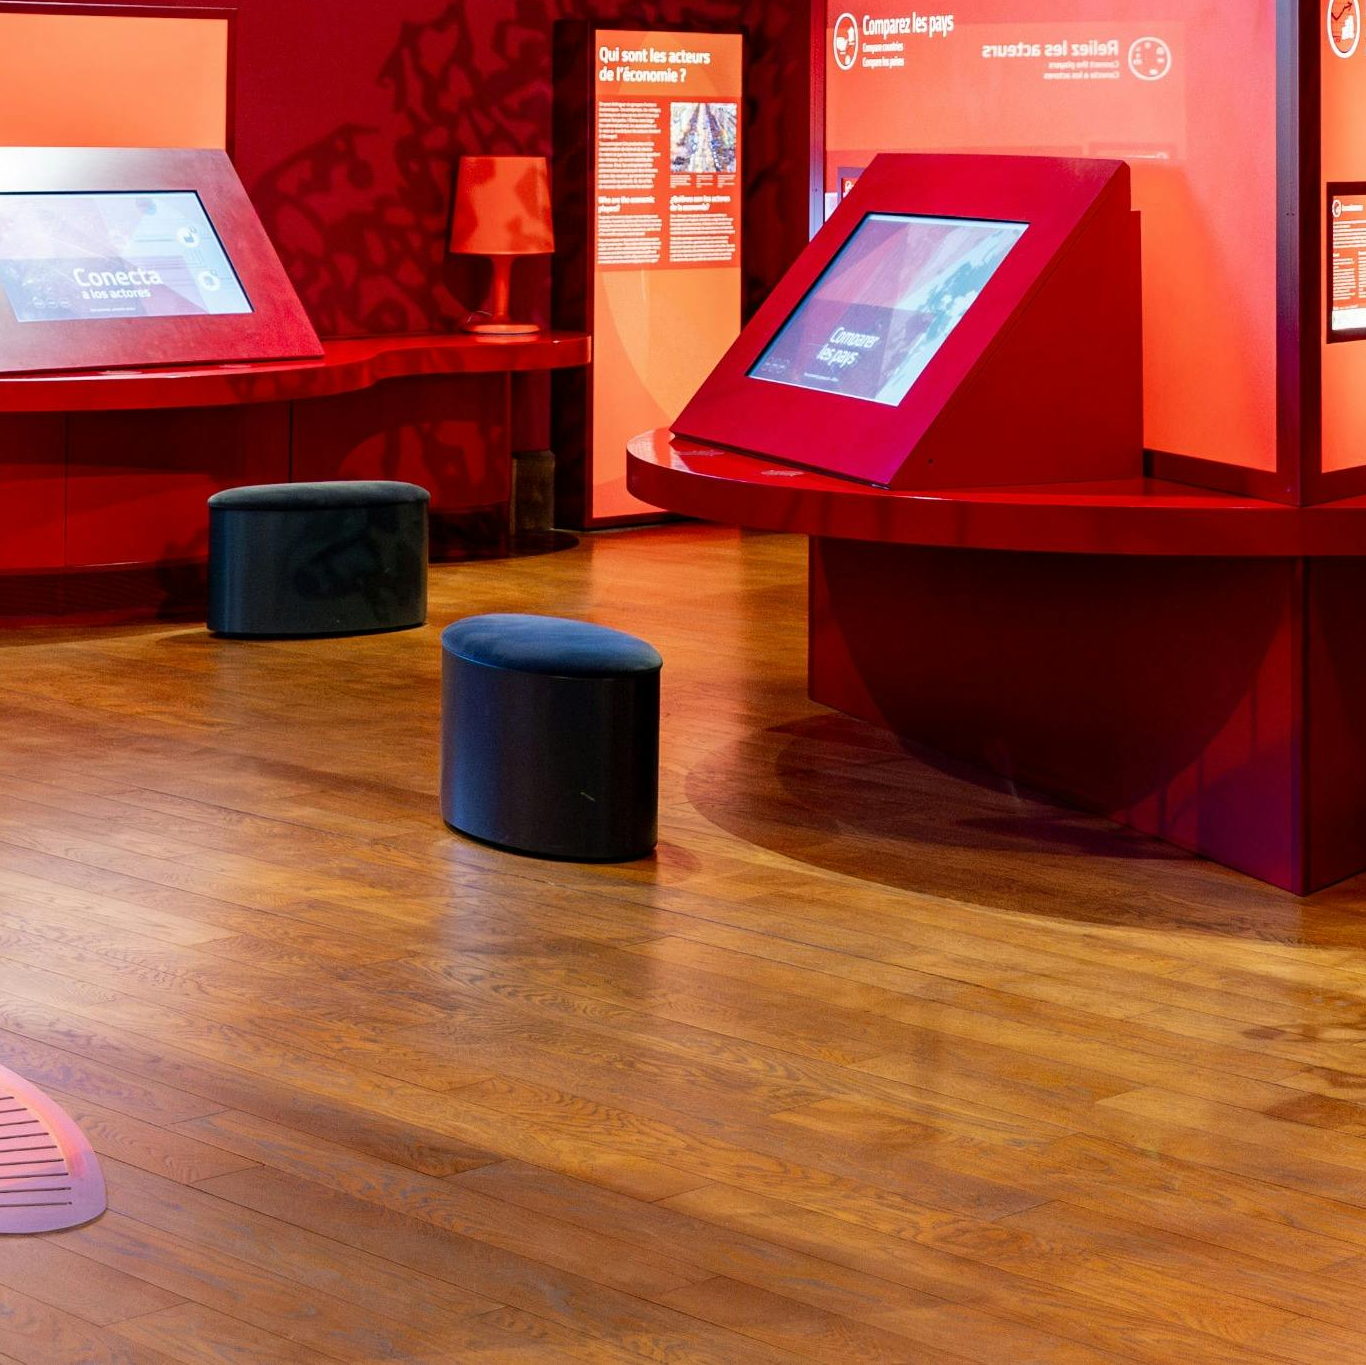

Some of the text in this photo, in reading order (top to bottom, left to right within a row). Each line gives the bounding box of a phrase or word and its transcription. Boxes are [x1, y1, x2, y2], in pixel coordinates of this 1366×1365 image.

[862, 11, 954, 40] Comparez les pays
[599, 46, 711, 64] Qui sont les acteurs
[599, 66, 687, 83] de l'économie ?
[72, 267, 163, 287] Conecta
[81, 288, 151, 300] a los actores
[829, 326, 880, 349] Comparer
[816, 343, 859, 369] les pays
